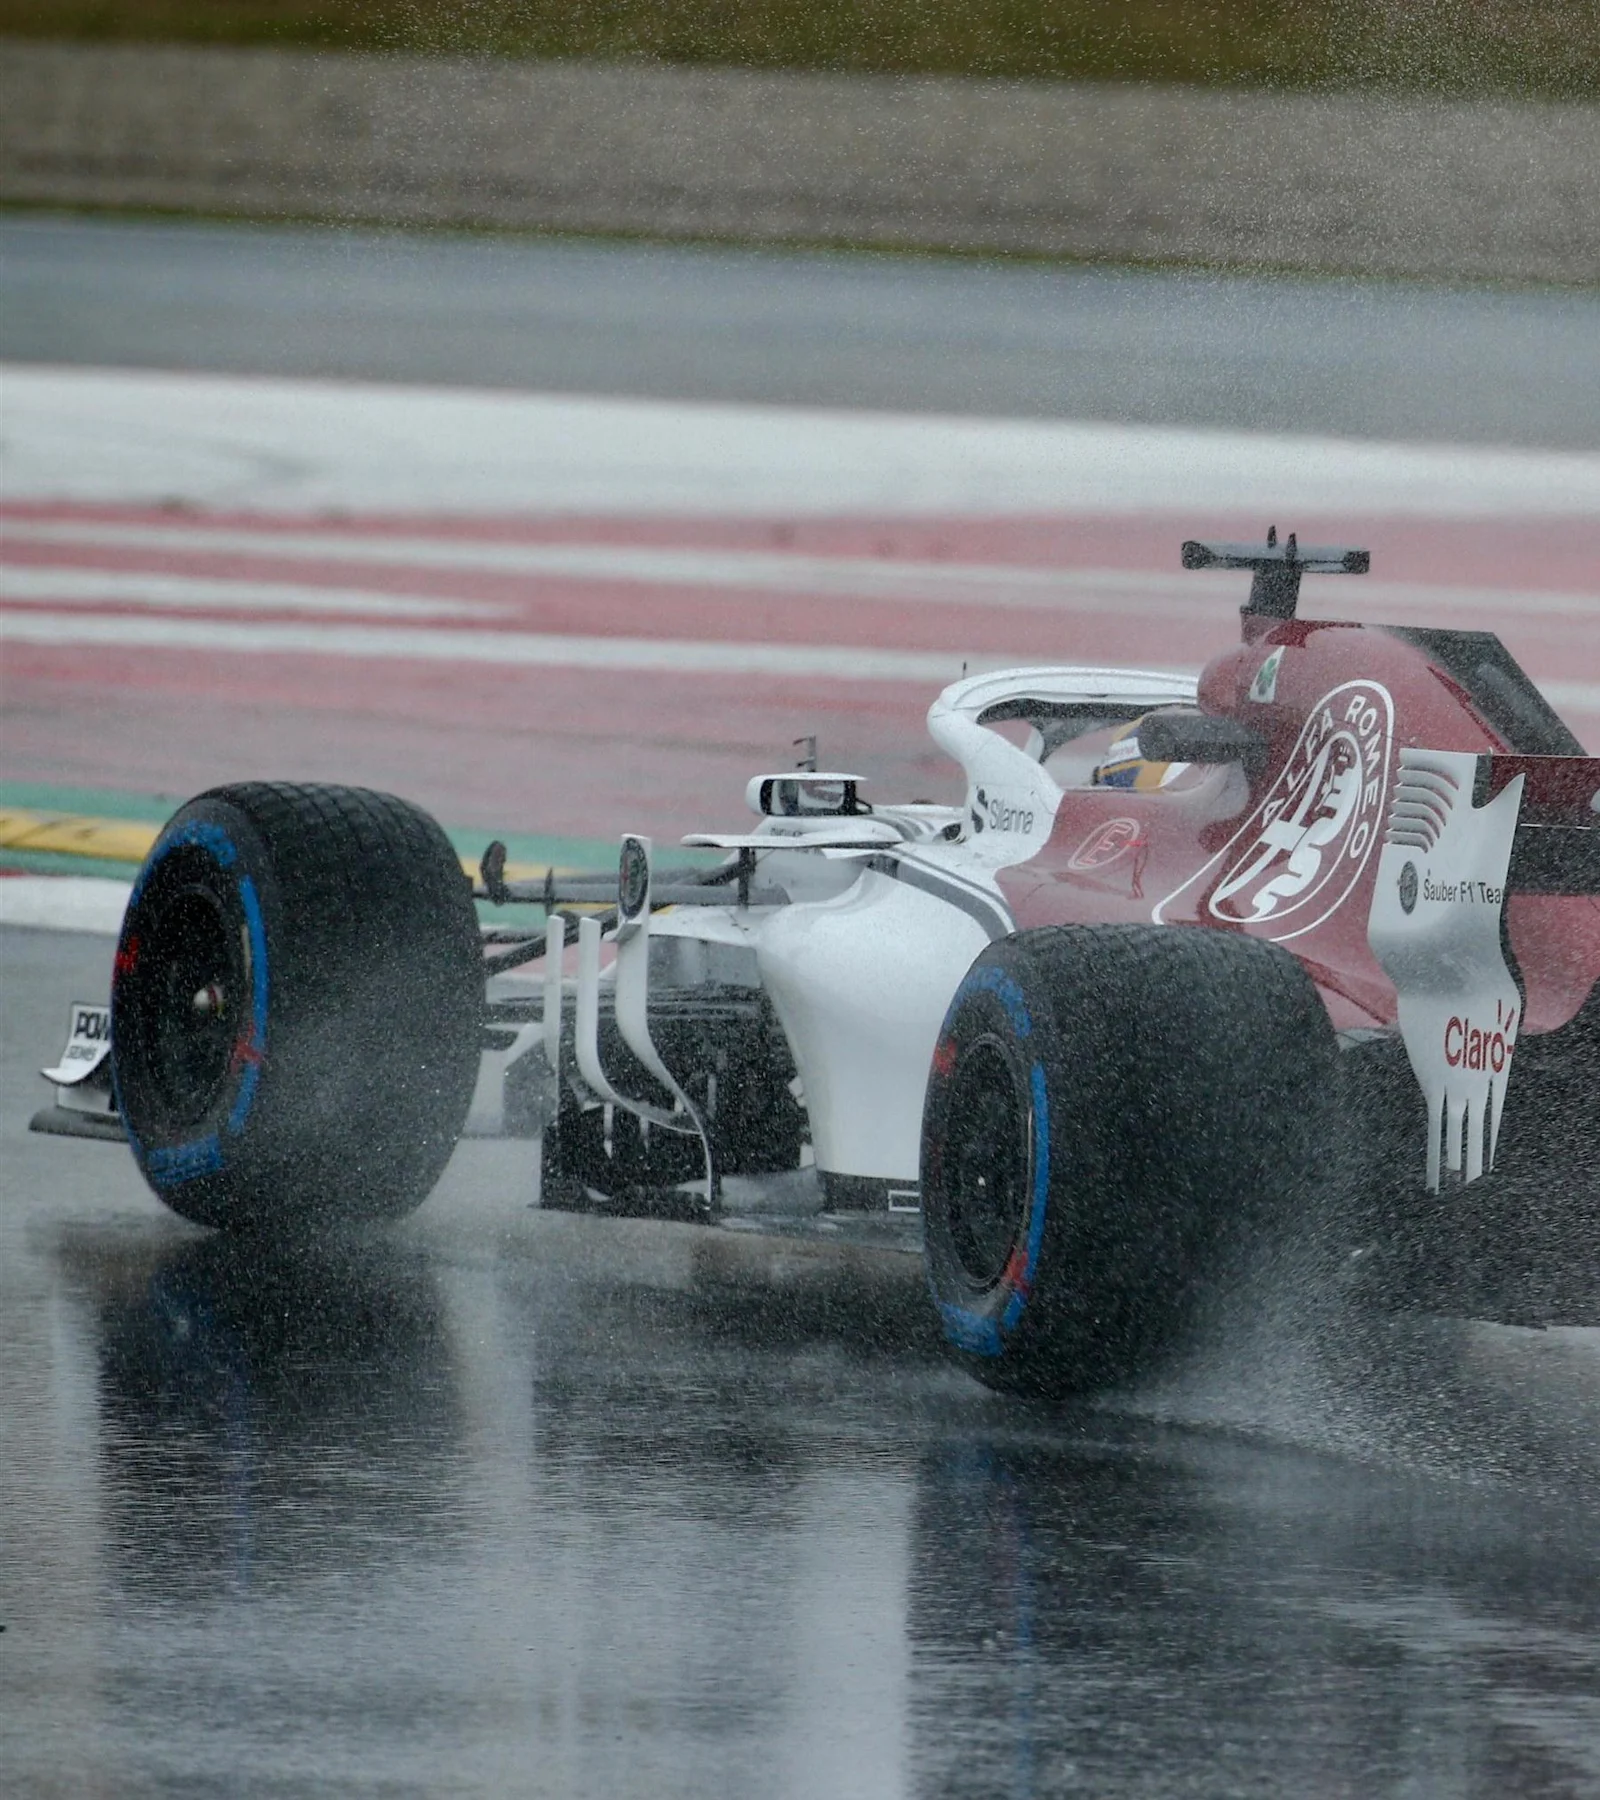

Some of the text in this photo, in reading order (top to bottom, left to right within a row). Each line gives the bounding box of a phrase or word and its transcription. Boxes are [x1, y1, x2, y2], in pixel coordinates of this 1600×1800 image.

[1262, 694, 1382, 859] ALFA ROMEO
[1423, 878, 1458, 902] Sauber
[1478, 881, 1503, 905] Tea
